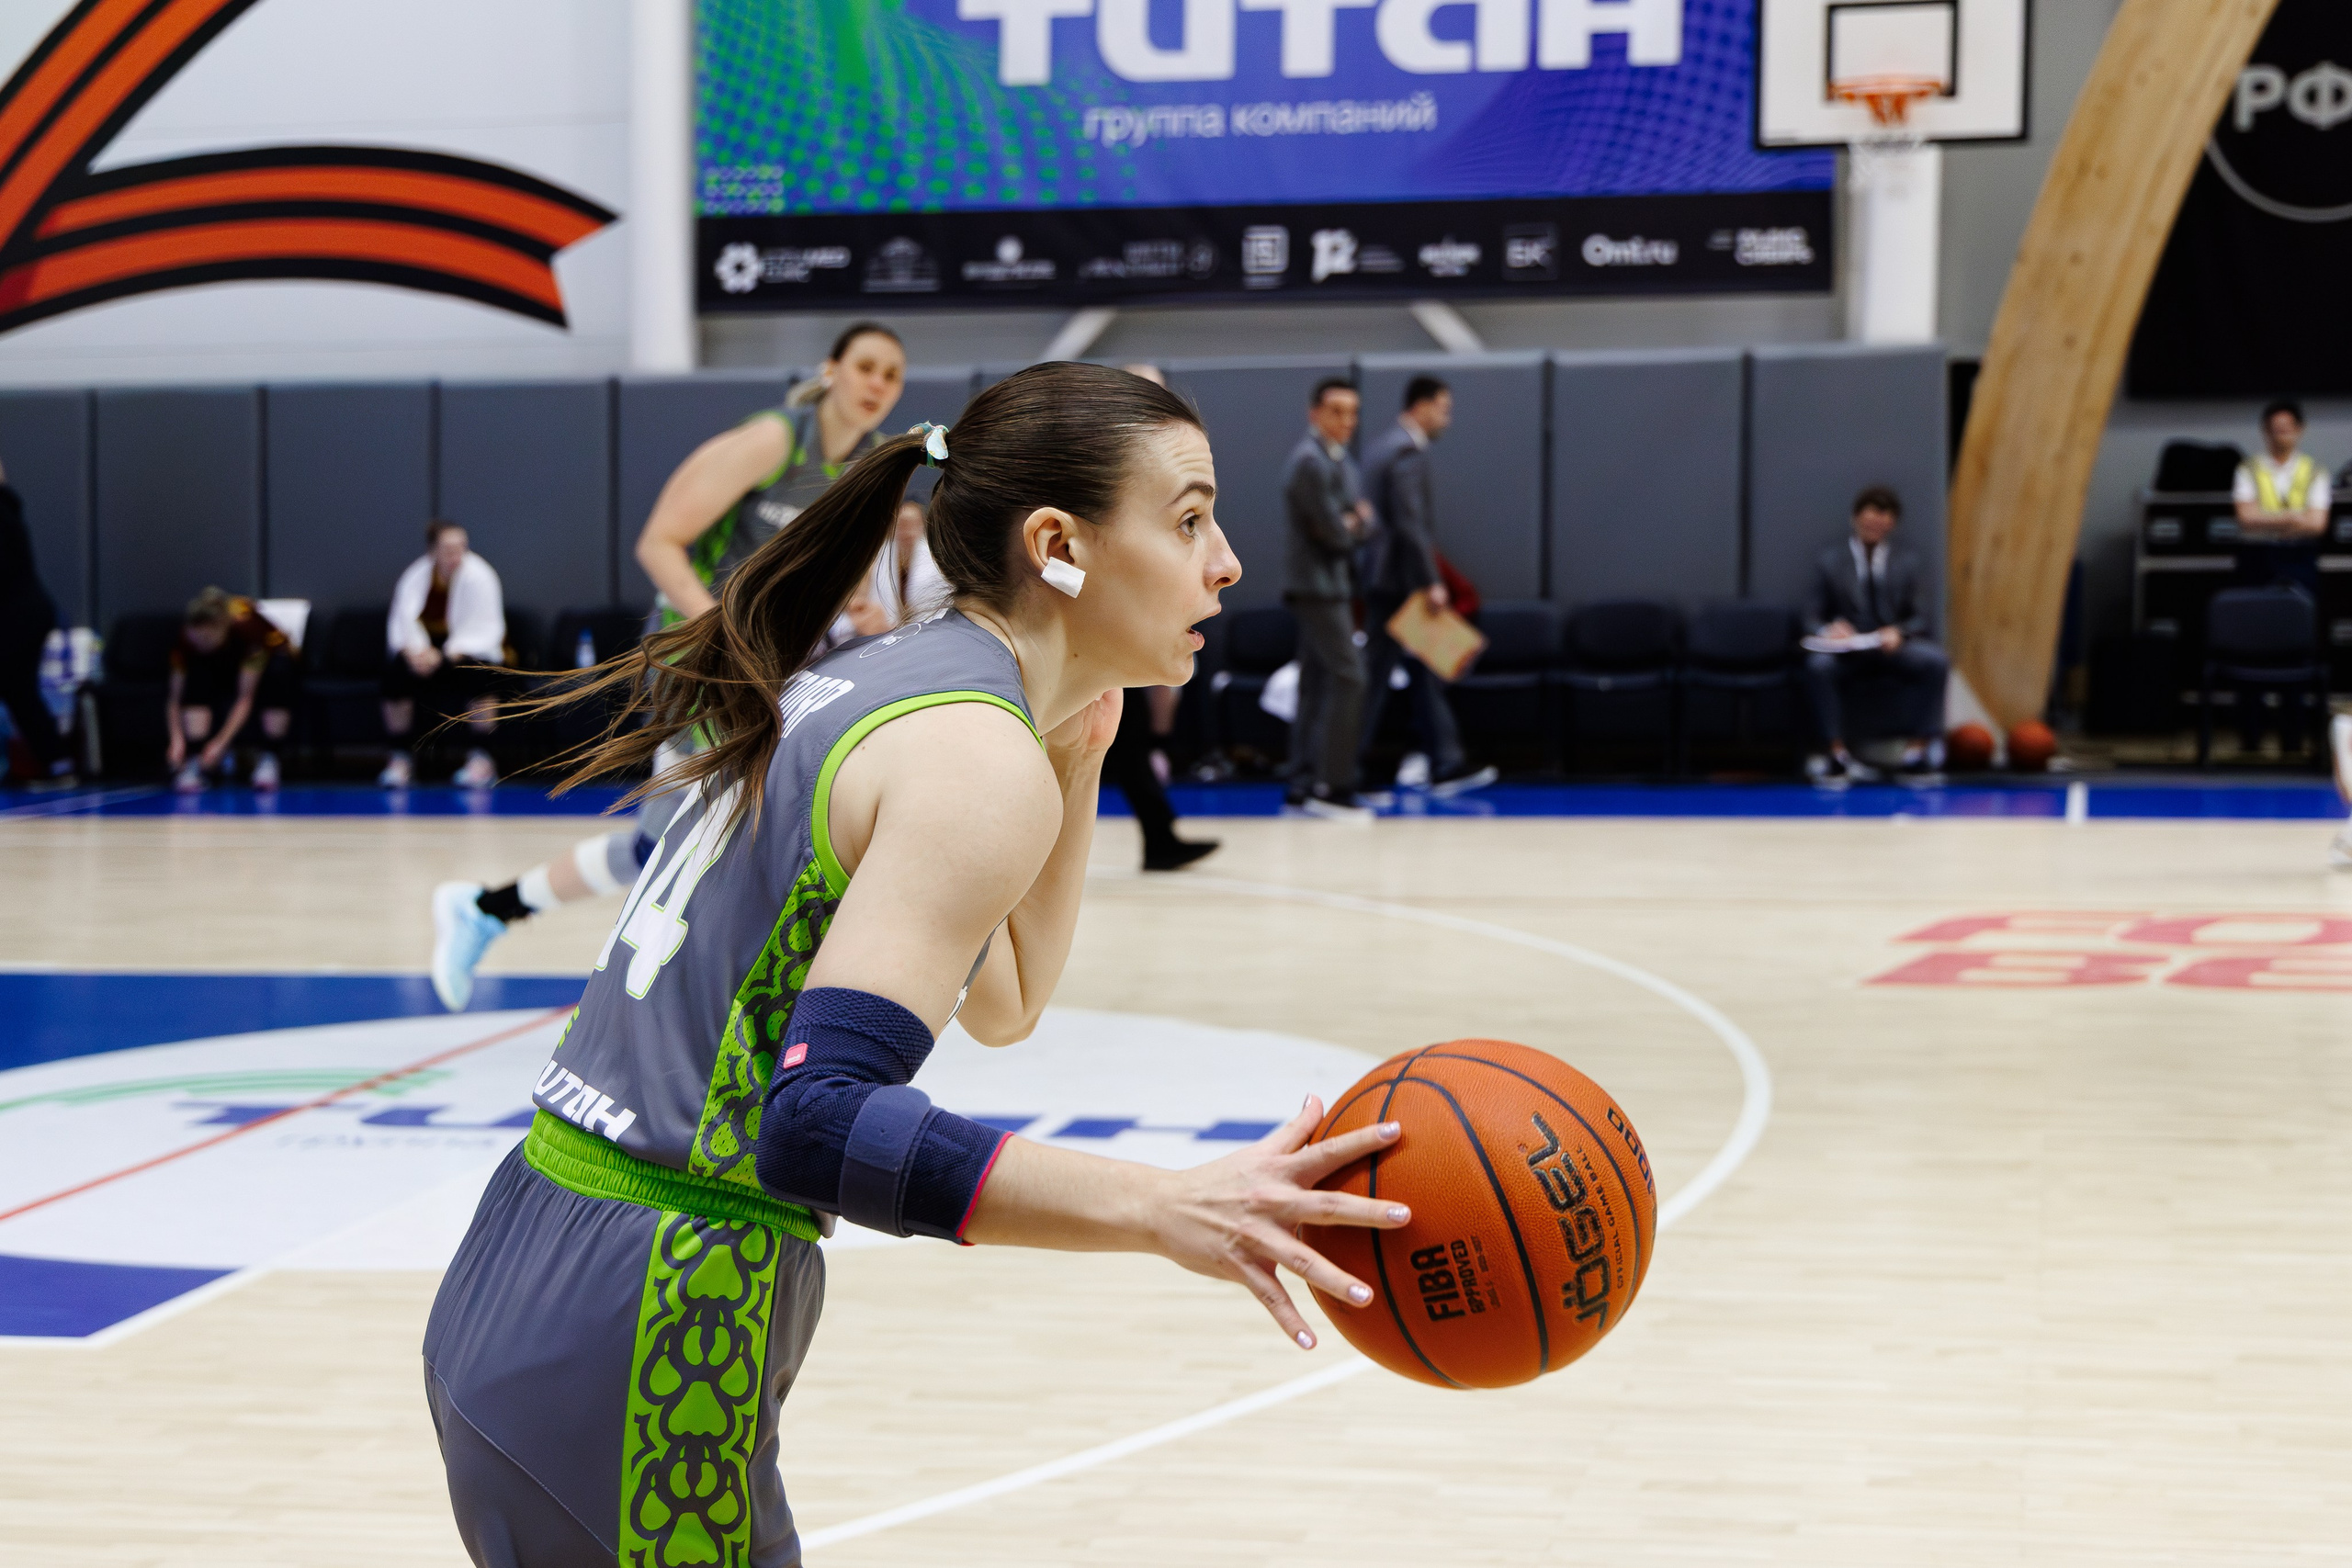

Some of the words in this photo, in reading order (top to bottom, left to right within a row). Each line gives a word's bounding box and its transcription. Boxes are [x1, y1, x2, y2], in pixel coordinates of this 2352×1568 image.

[1082, 104, 1226, 148] группа
[1231, 90, 1437, 136] компаний
[1577, 1145, 1598, 1182] BALL
[1597, 1185, 1615, 1226] GAME
[1410, 1243, 1465, 1322] FIBA
[1451, 1240, 1486, 1314] APPROVED
